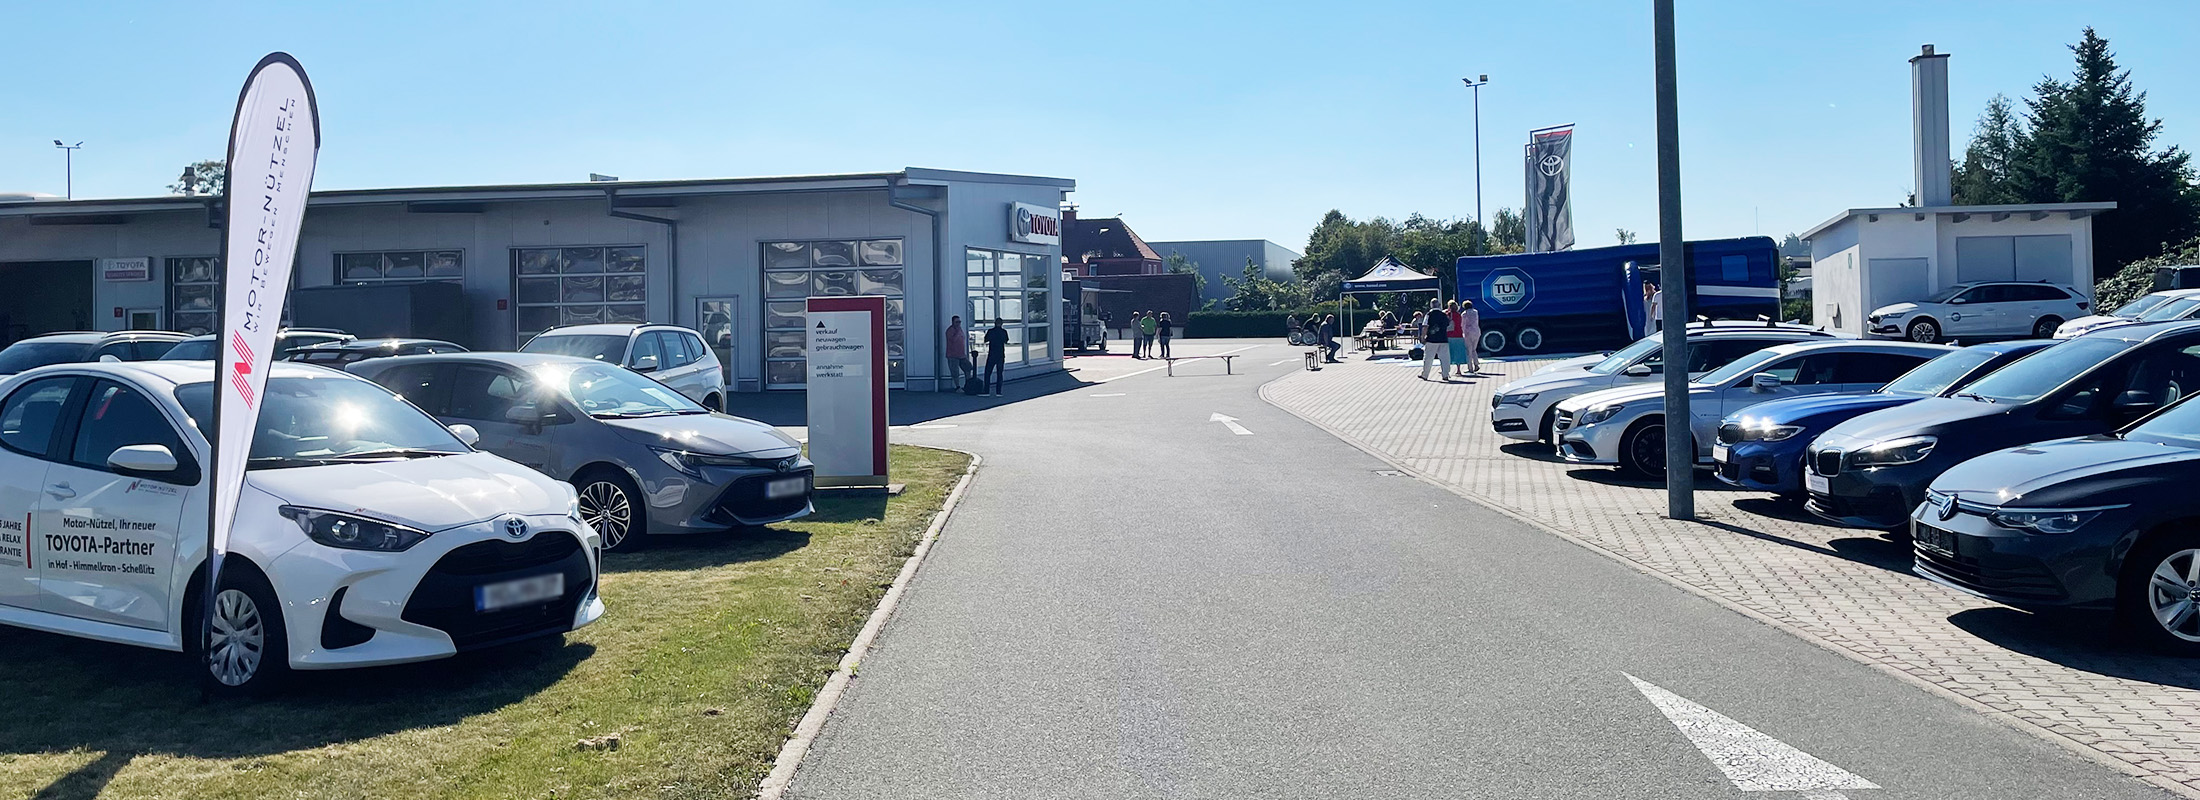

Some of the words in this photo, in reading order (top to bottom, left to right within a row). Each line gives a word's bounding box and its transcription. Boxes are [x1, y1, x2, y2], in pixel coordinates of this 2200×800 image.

[276, 99, 296, 193] MENSCHEN
[243, 97, 289, 332] MOTOR-NÜTZEL
[1029, 213, 1059, 237] TOYOTA
[116, 261, 145, 269] TOYOTA
[1494, 282, 1522, 294] TÜV
[3, 520, 22, 531] JAHRE
[63, 517, 118, 531] Motor-Nützel,
[119, 519, 131, 530] Ihr
[132, 521, 157, 531] neuer
[2, 533, 22, 544] RELAX
[45, 533, 156, 556] TOYOTA-Partner
[48, 558, 56, 569] in
[56, 559, 69, 570] Hof
[73, 560, 117, 574] Himmelkron
[122, 562, 156, 575] Scheßlitz
